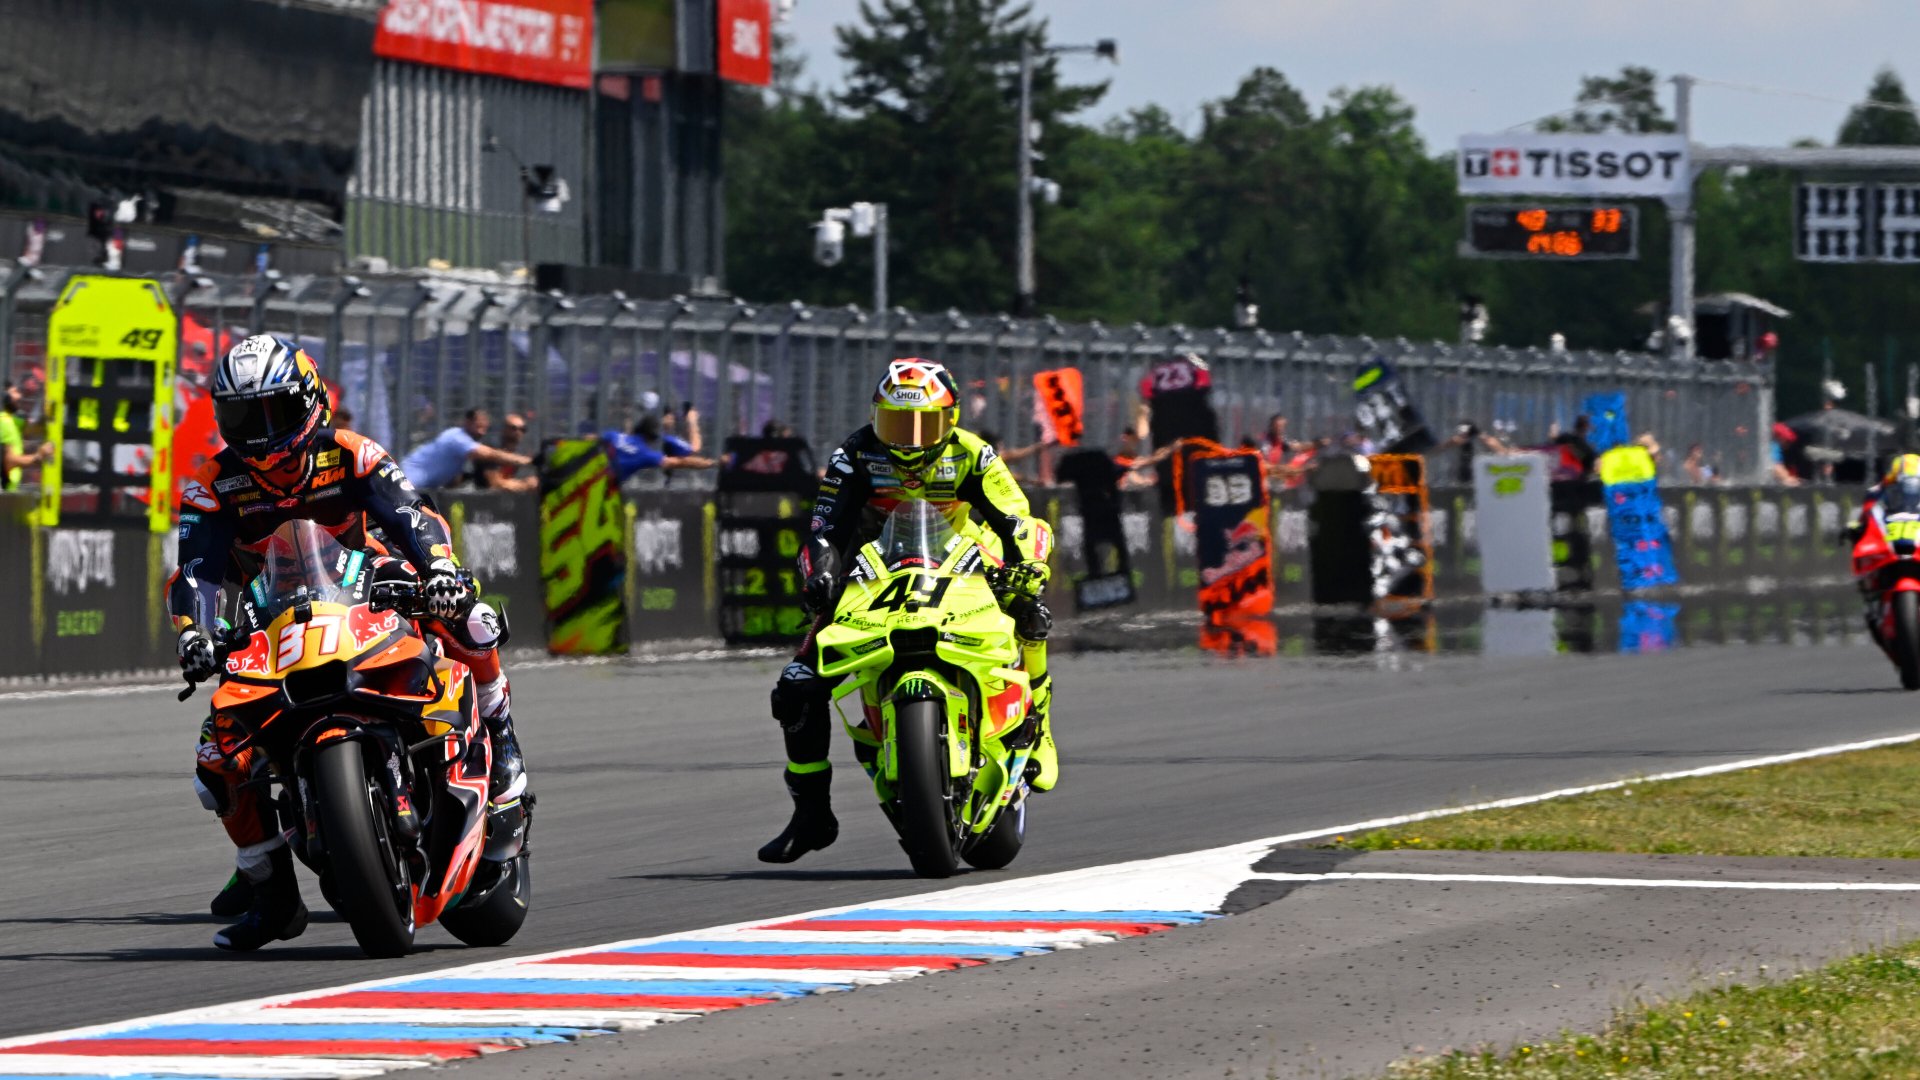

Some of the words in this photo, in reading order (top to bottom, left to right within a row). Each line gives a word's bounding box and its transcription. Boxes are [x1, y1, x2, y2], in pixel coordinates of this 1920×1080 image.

[1525, 150, 1681, 179] TISSOT
[121, 328, 164, 350] 49
[1154, 364, 1194, 391] 23
[896, 390, 920, 400] SHOEI
[311, 466, 346, 489] KTM
[870, 464, 891, 473] SHOEI
[355, 571, 366, 592] BAJAJ
[867, 574, 953, 613] 49
[247, 608, 260, 629] BAJAJ
[897, 615, 928, 625] HERO
[959, 602, 996, 619] PERTAMINA
[851, 618, 887, 629] PERTAMINA
[275, 614, 345, 674] 37
